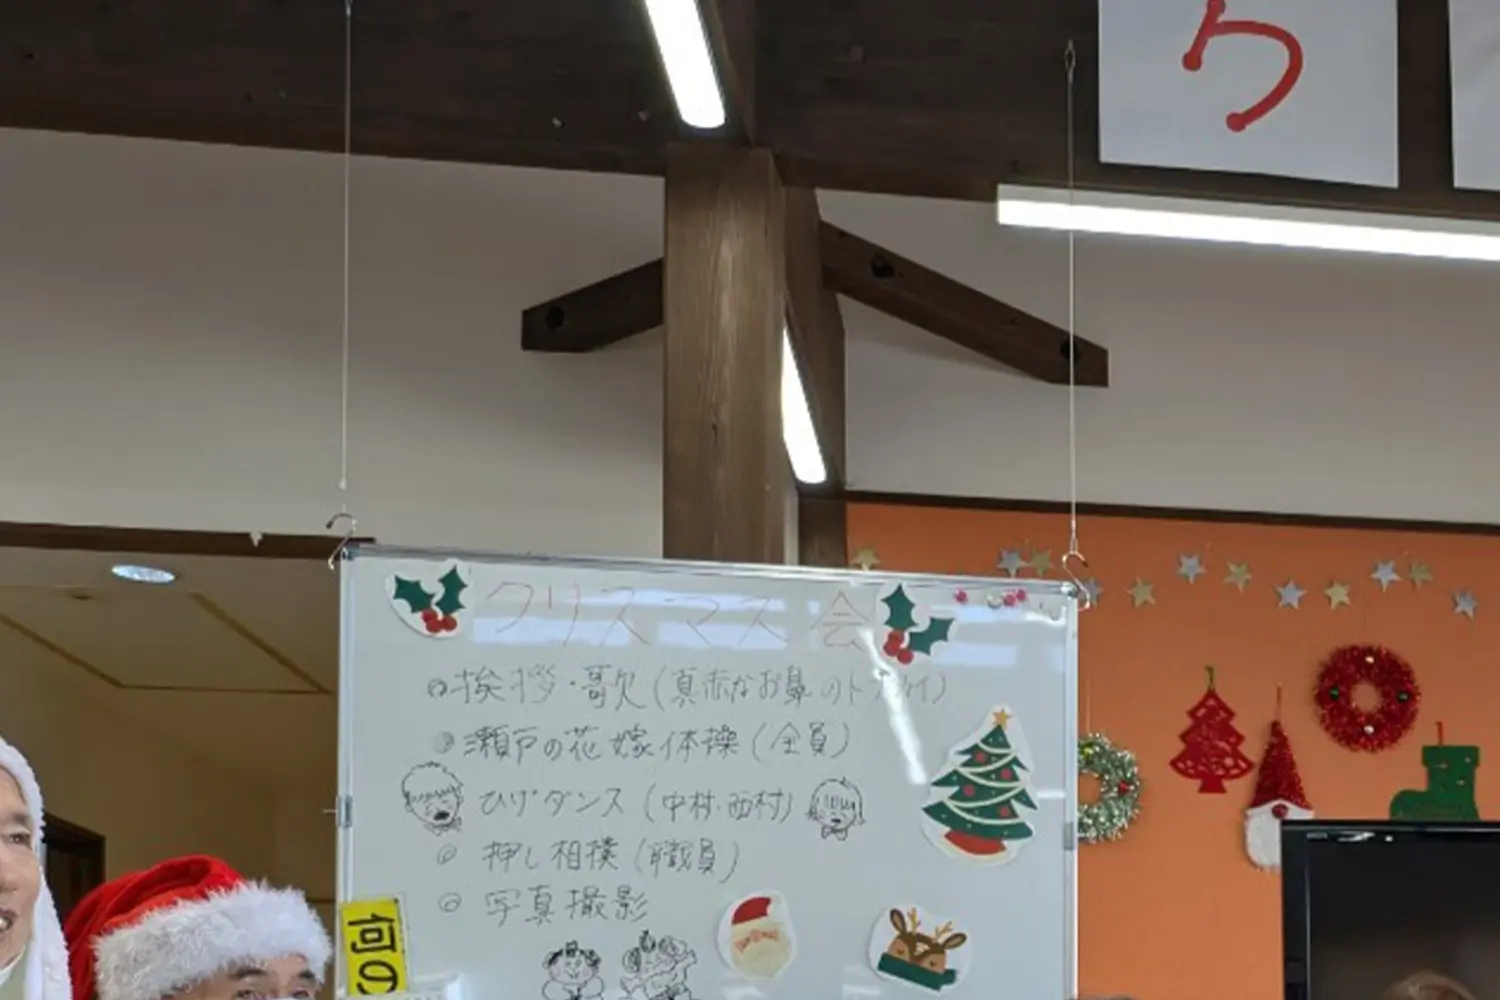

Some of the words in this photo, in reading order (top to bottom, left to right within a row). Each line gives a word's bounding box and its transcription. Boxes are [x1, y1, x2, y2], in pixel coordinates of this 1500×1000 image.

[485, 581, 872, 650] クリスマス会
[484, 885, 649, 927] 写真撮影
